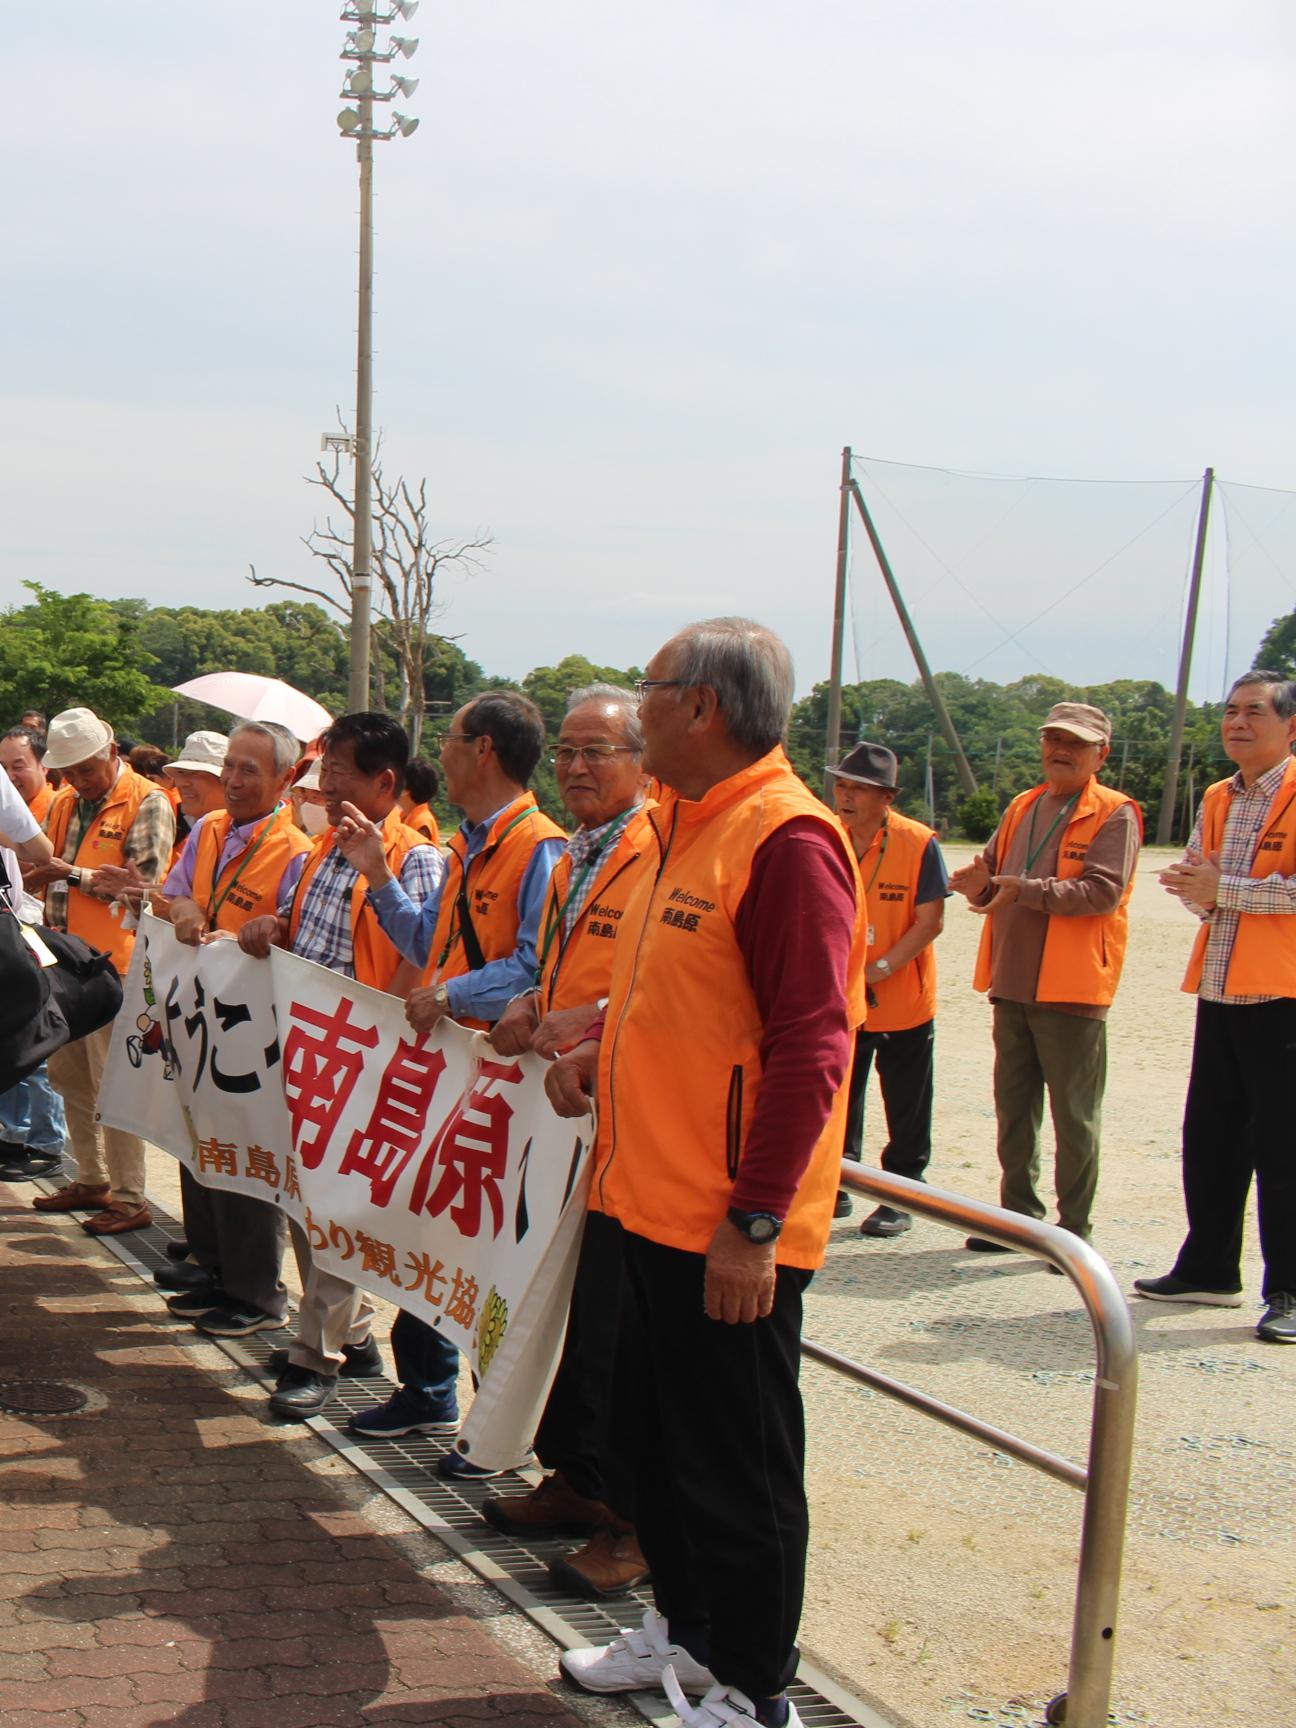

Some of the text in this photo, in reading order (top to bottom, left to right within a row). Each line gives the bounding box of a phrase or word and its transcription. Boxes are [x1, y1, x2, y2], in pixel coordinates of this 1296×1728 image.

[668, 887, 716, 913] Welcome
[590, 903, 624, 920] Welco
[660, 907, 701, 932] 南島原
[587, 921, 618, 939] 南島
